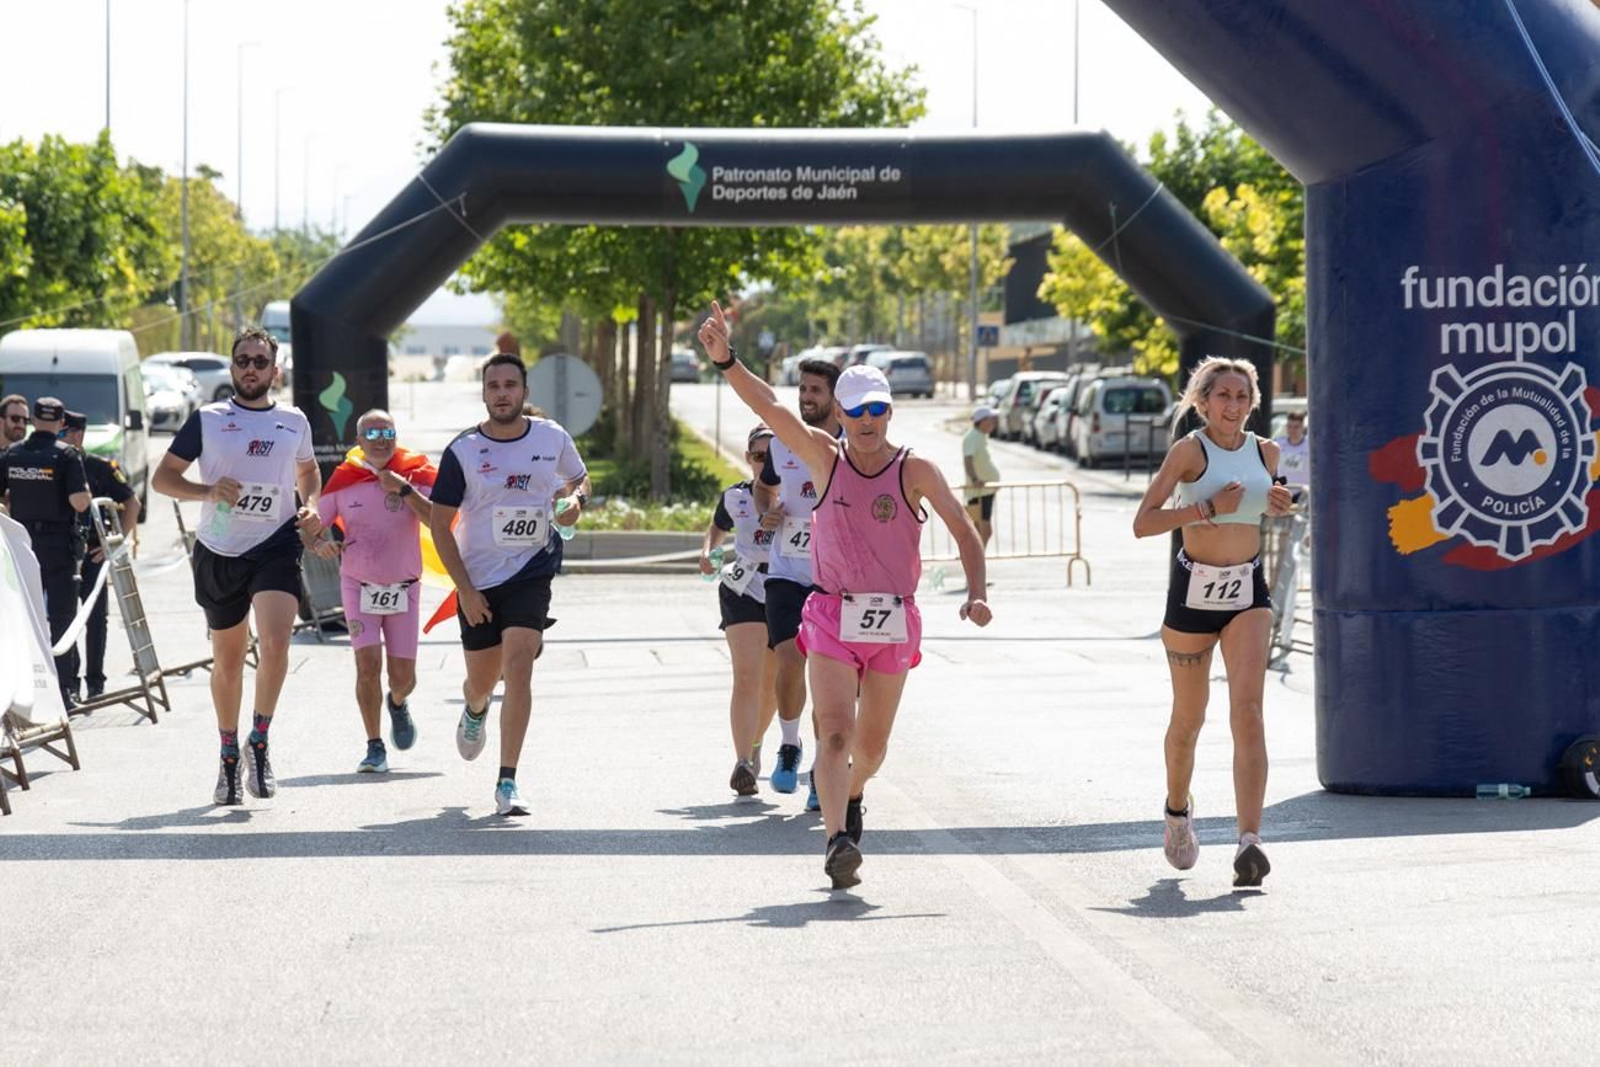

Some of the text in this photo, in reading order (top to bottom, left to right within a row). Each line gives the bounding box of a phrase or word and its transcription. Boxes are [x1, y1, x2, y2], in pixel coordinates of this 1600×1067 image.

[712, 165, 901, 184] Patronato Municipal de
[712, 184, 858, 203] Deportes de Jaén
[1441, 310, 1576, 363] mupol
[1451, 386, 1572, 463] Fundación de la Mutualidad de la
[236, 494, 273, 513] 479
[1481, 495, 1546, 515] POLICÍA
[501, 519, 538, 536] 480
[789, 531, 812, 548] 47
[370, 591, 400, 606] 161
[1203, 579, 1242, 600] 112
[860, 609, 892, 629] 57
